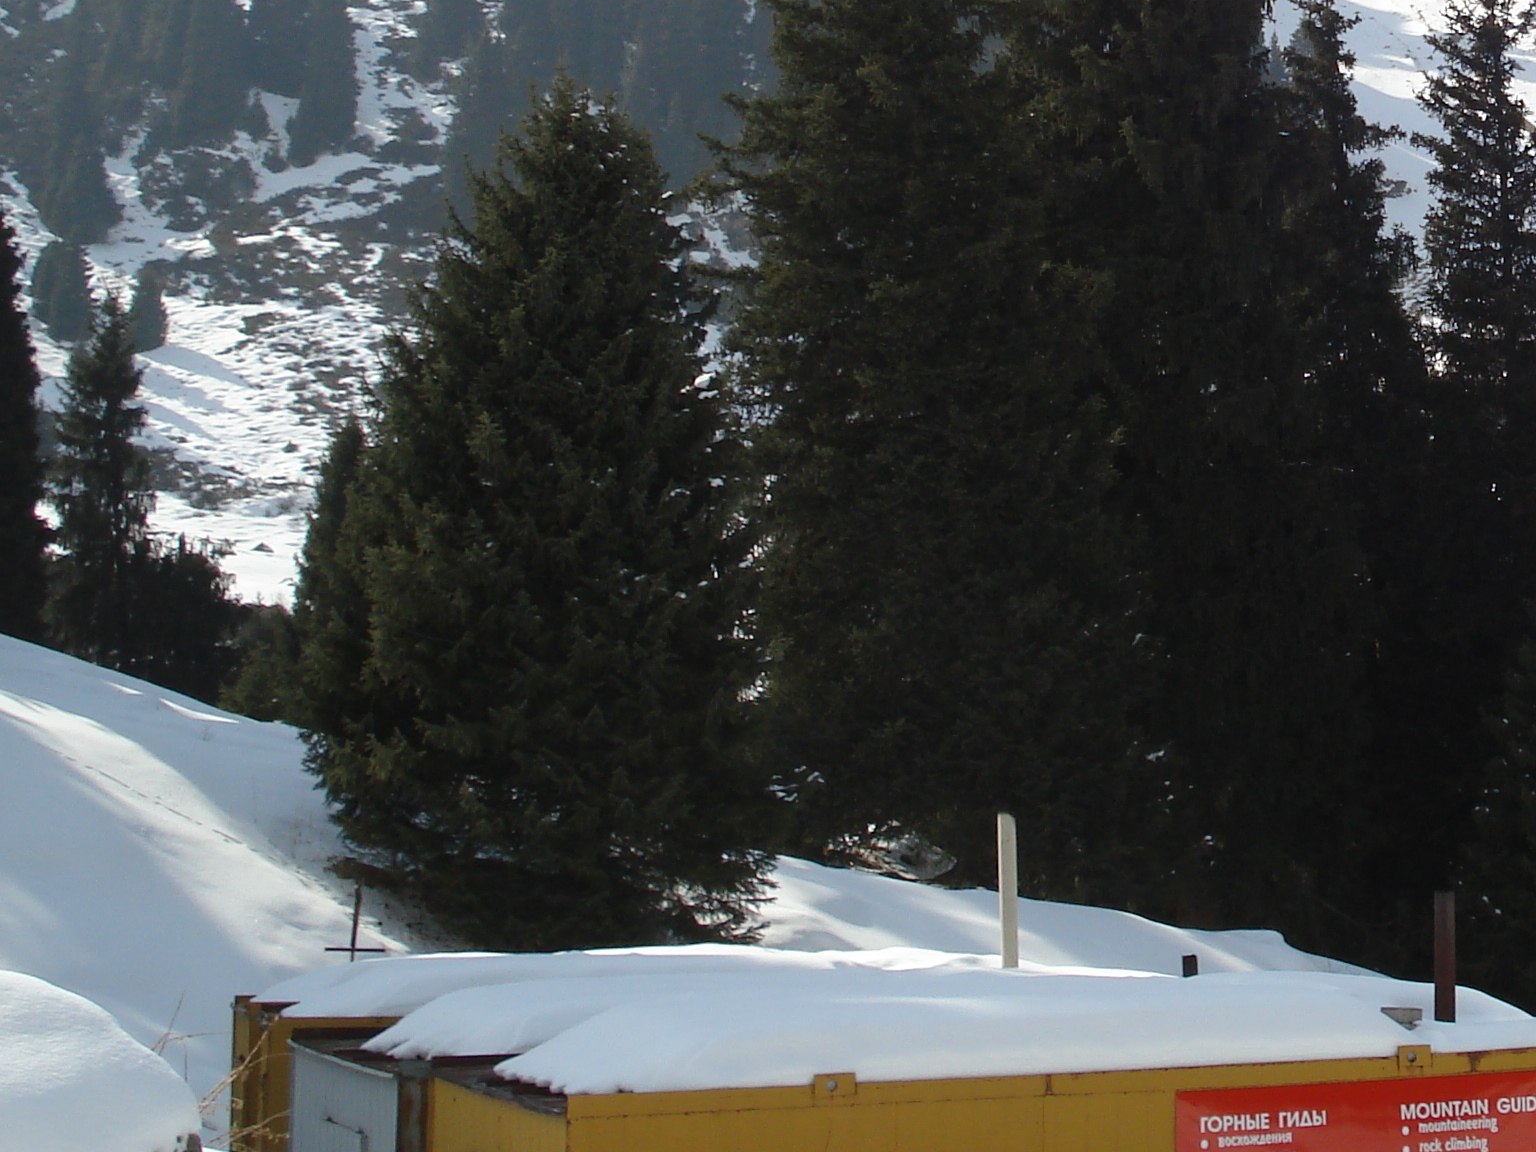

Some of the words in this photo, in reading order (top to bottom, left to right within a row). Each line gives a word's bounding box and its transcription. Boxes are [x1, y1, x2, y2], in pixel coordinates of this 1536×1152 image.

[1400, 1098, 1490, 1121] MOUNTAIN
[1200, 1112, 1270, 1134] ГОРНЫЕ
[1278, 1110, 1327, 1128] ГИДЫ
[1418, 1116, 1499, 1133] mountaineering
[1419, 1137, 1442, 1152] rock
[1445, 1135, 1489, 1152] climbing
